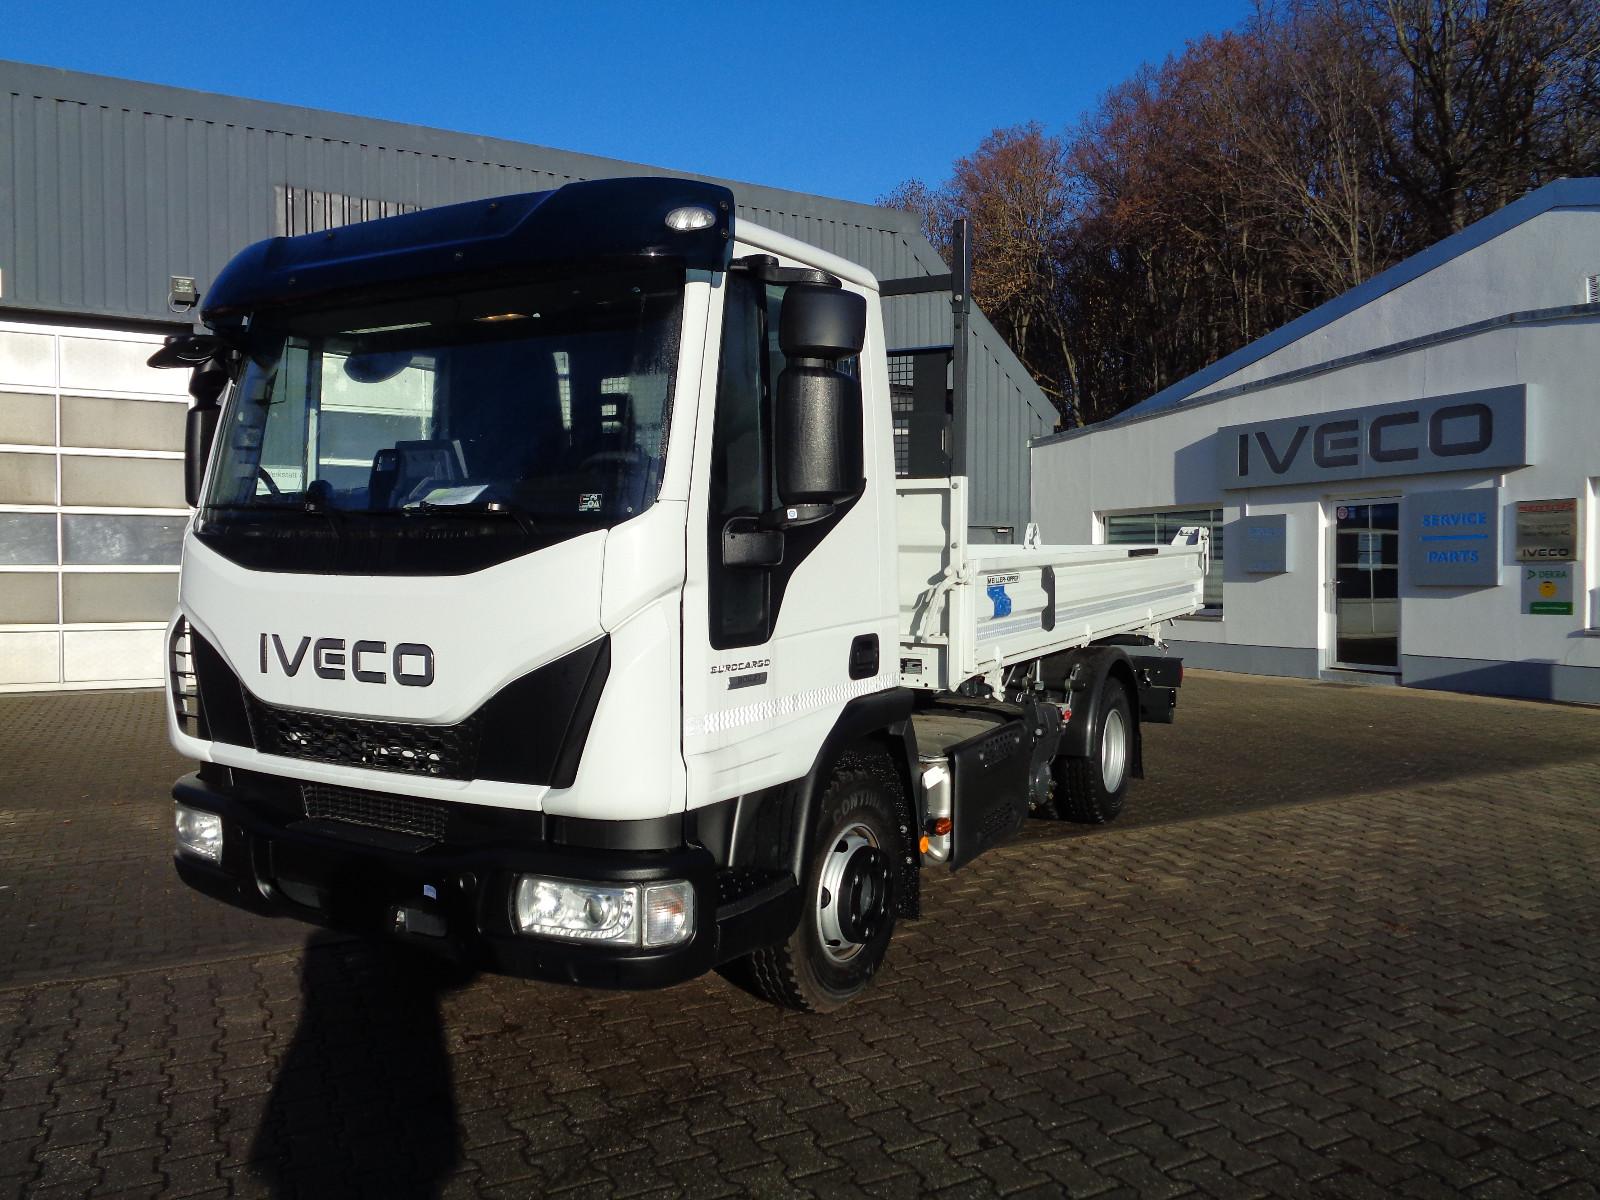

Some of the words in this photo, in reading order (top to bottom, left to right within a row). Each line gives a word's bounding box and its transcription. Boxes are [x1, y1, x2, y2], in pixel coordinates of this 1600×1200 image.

[1237, 403, 1493, 477] IVECO
[1422, 512, 1487, 527] SERVICE
[1427, 551, 1479, 565] PARTS
[1523, 549, 1569, 557] IVECO
[259, 633, 434, 687] IVECO
[710, 659, 770, 674] EUROCARGO
